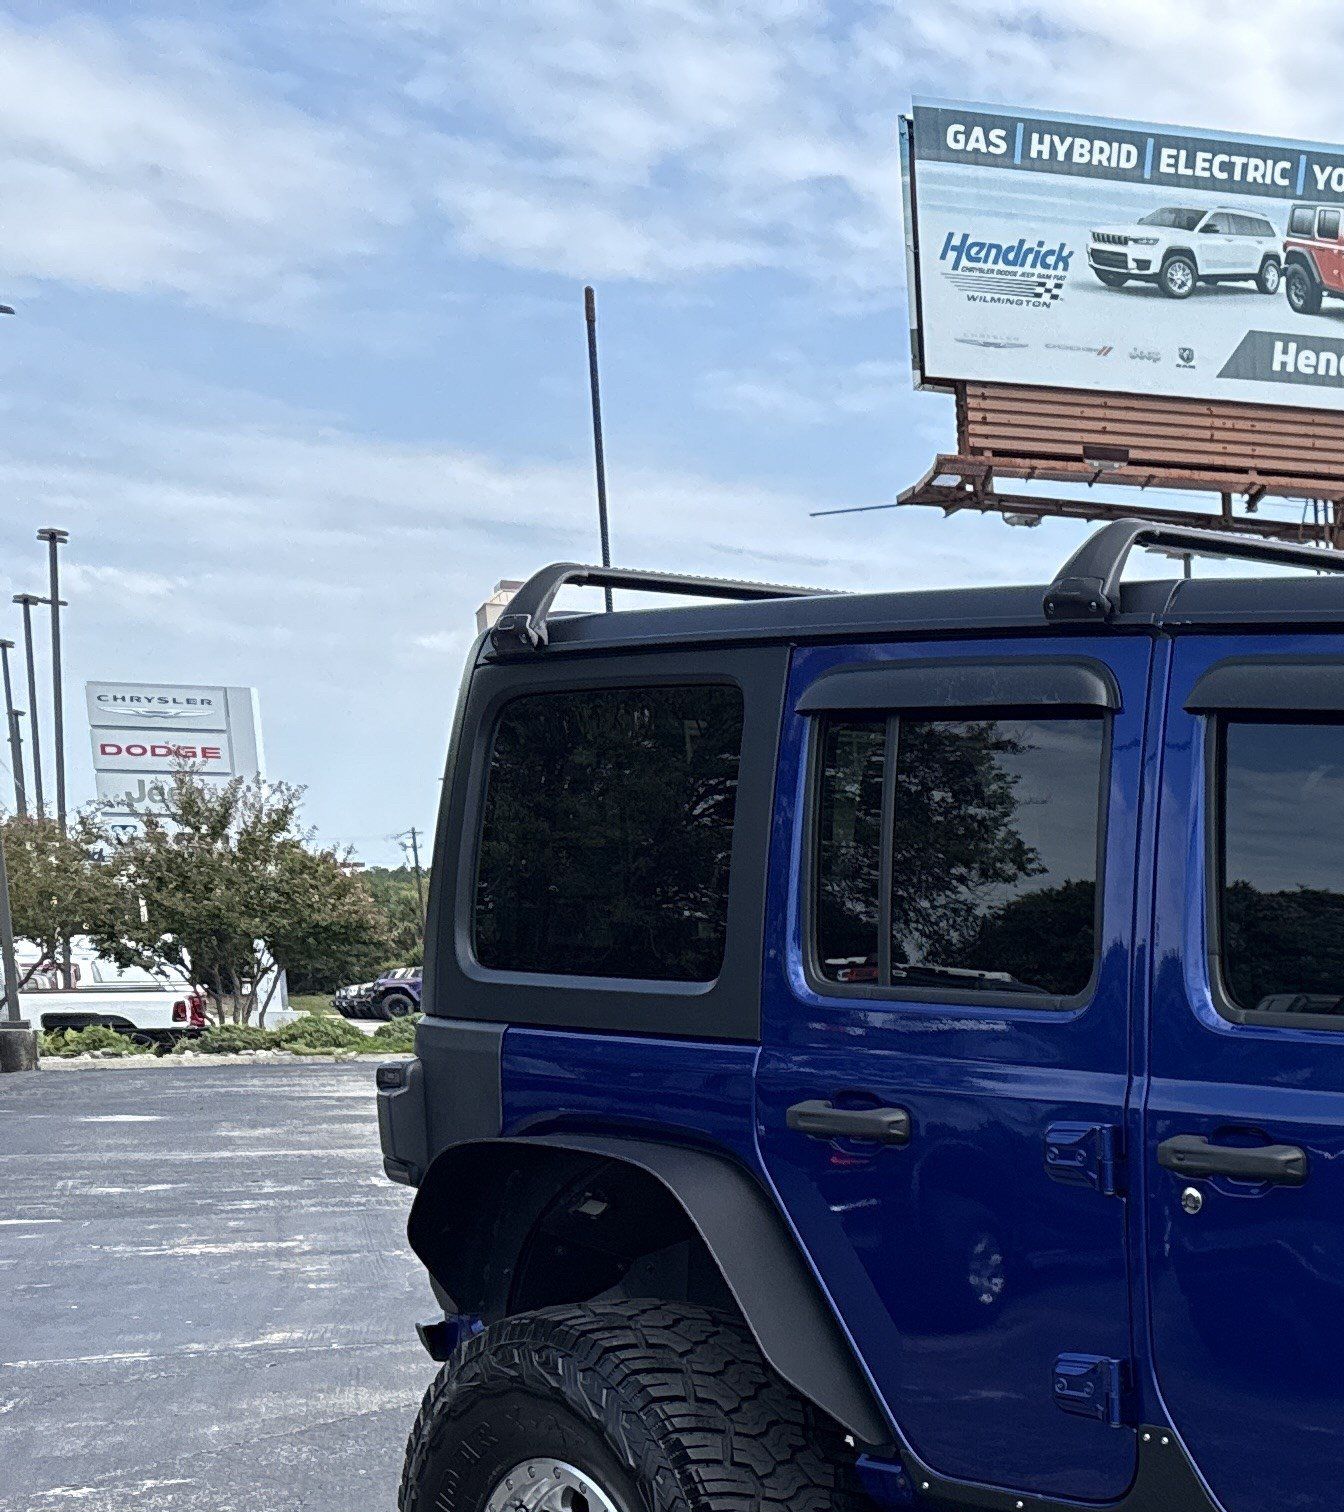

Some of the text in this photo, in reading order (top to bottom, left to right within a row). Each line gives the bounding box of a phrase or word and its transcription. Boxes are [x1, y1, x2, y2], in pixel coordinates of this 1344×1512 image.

[946, 123, 1008, 154] GAS
[1030, 132, 1138, 169] HYBRID
[1159, 147, 1292, 186] ELECTRIC
[939, 231, 1075, 272] Hendrick
[966, 293, 1052, 309] WILMINGTON
[96, 693, 213, 707] CHRYSLER
[100, 743, 222, 760] DODGE
